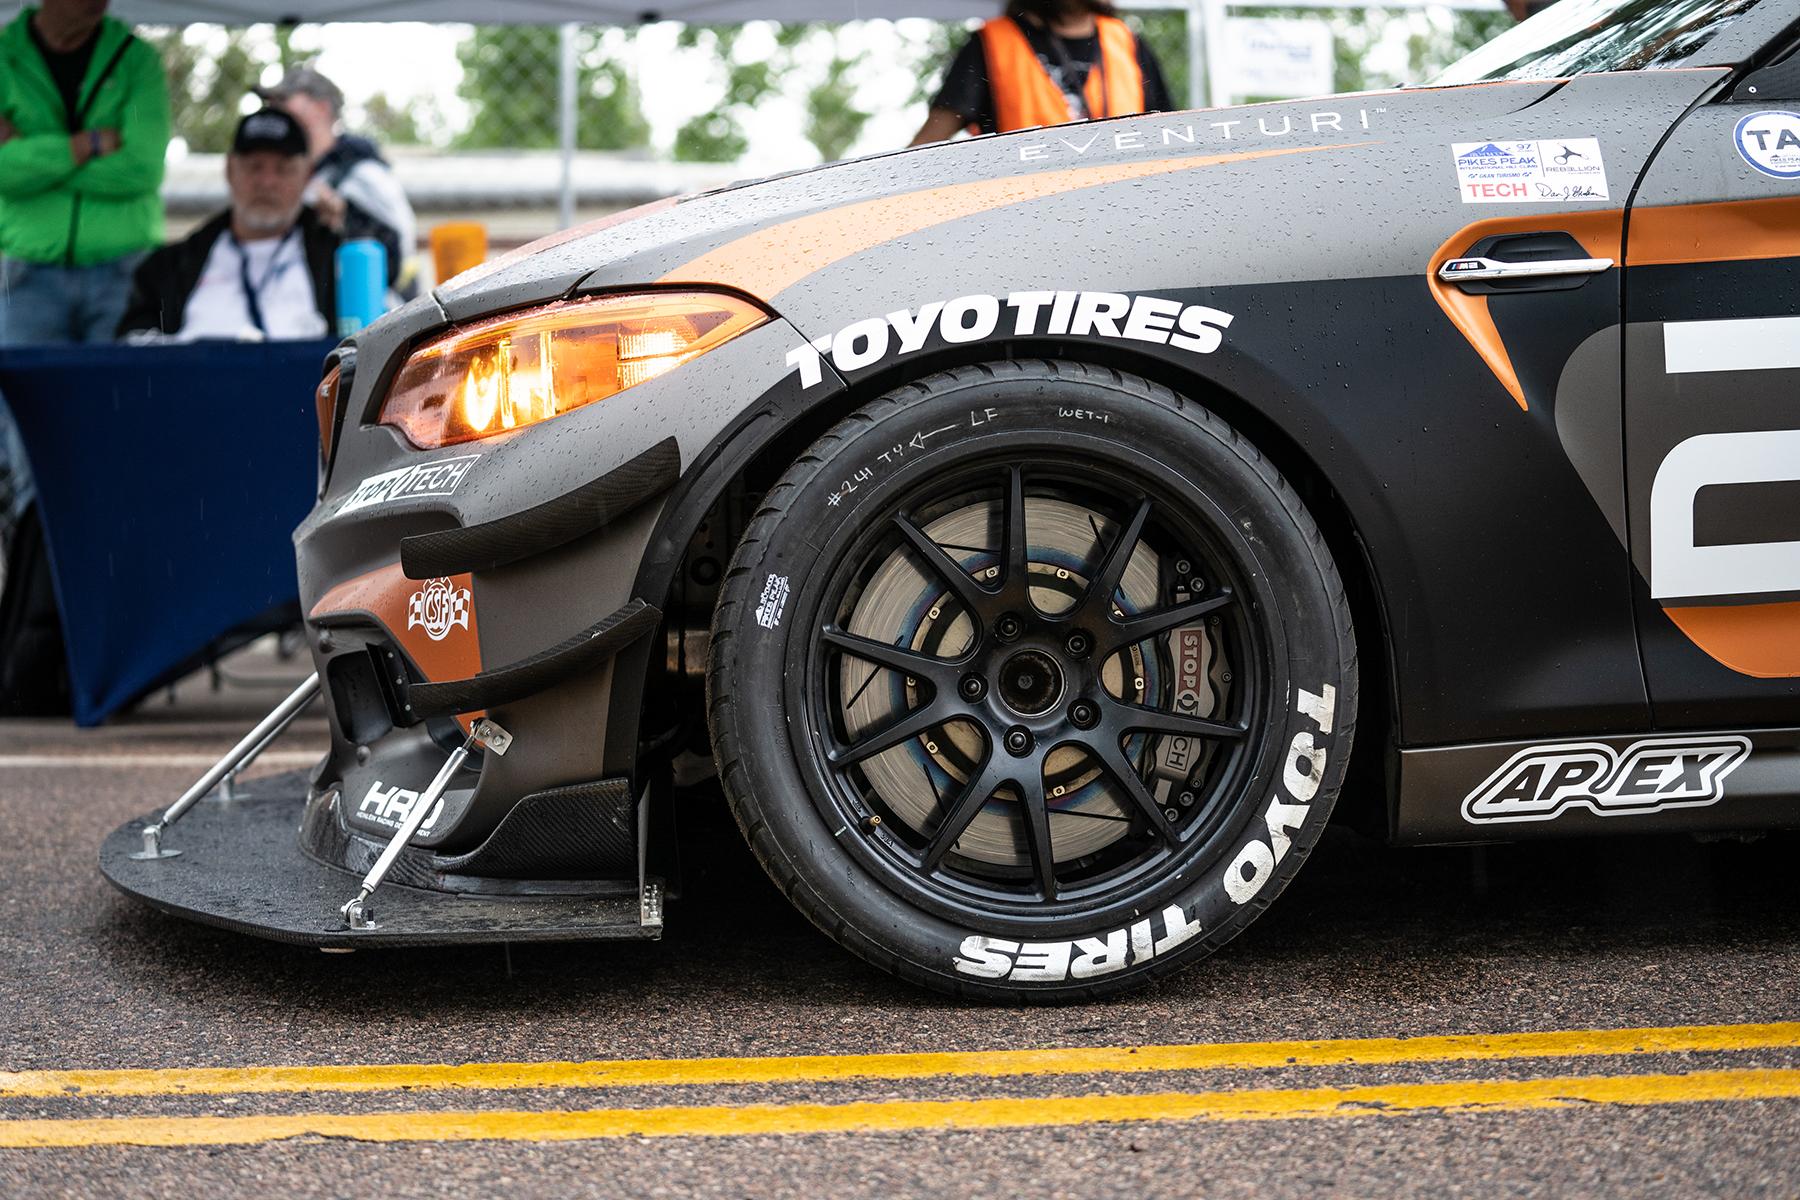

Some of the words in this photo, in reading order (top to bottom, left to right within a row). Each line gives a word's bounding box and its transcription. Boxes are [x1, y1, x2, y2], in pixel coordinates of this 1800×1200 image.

[1020, 108, 1370, 161] EVENTURI
[1458, 157, 1498, 166] PIKES
[1500, 156, 1537, 165] PEAK
[1466, 182, 1528, 198] TECH
[785, 293, 1000, 390] TOYO
[1006, 290, 1235, 354] TIRES
[827, 466, 873, 507] #241
[970, 407, 998, 427] LF
[424, 588, 449, 624] CSF
[1223, 683, 1337, 905] TOYO
[1482, 749, 1733, 808] APEX
[952, 903, 1203, 981] TIRES
